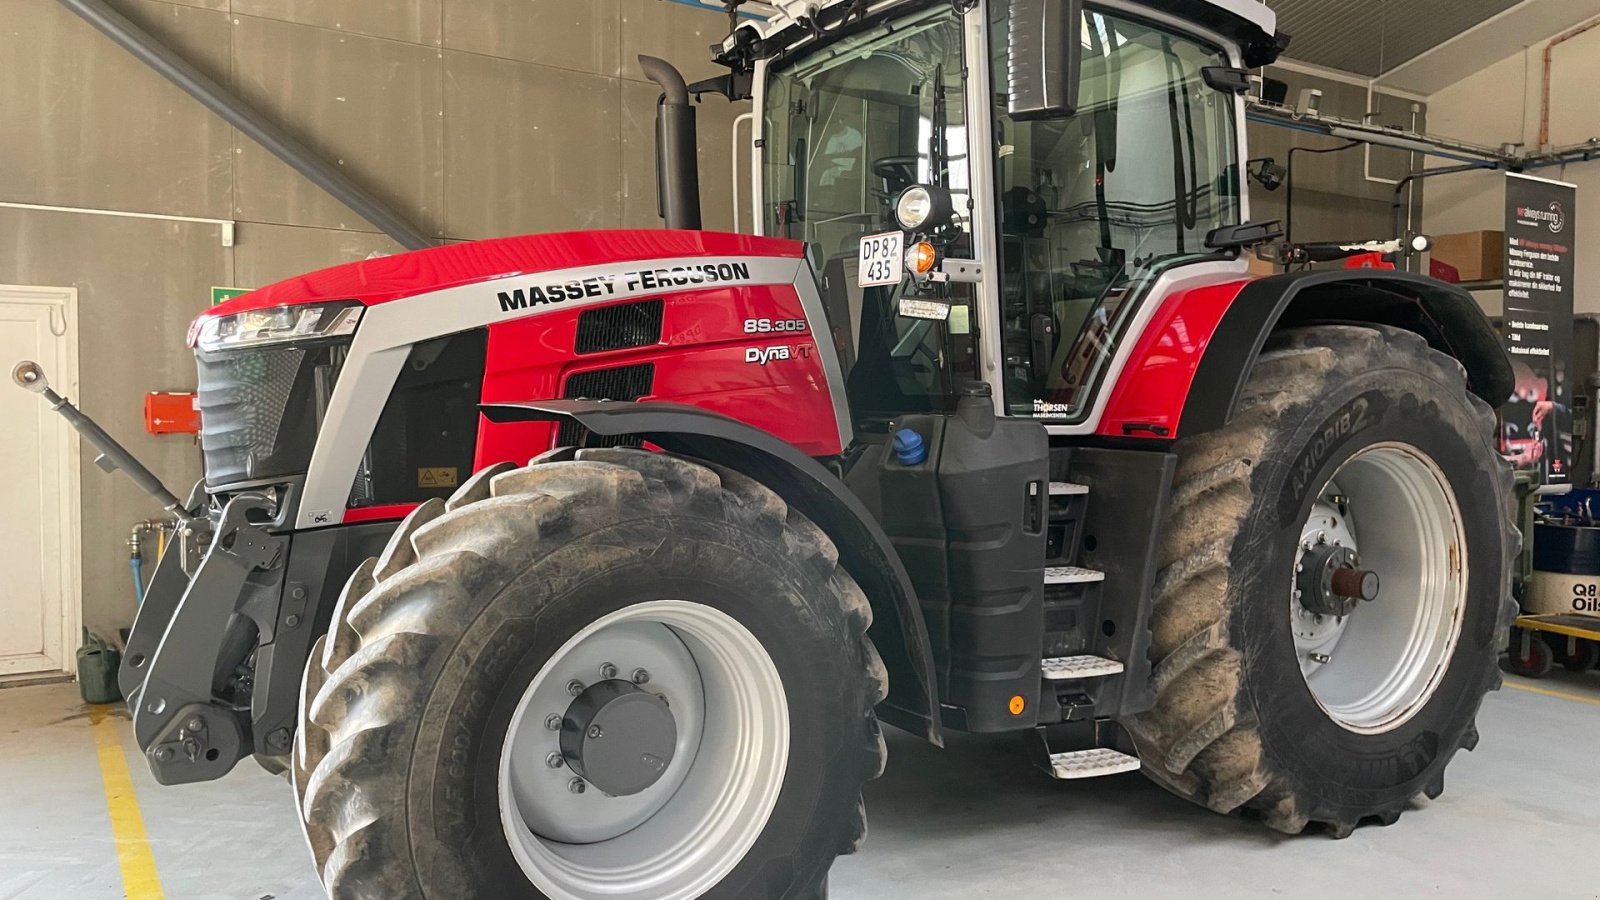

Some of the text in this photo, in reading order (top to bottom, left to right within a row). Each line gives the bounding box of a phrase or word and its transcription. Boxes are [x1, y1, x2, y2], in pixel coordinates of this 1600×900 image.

[864, 237, 897, 260] DP82
[868, 260, 890, 281] 435
[497, 262, 750, 312] MASSEY FERGUSON
[744, 318, 806, 333] 8S.305
[745, 343, 812, 365] DynaVT
[1572, 583, 1597, 597] Q8
